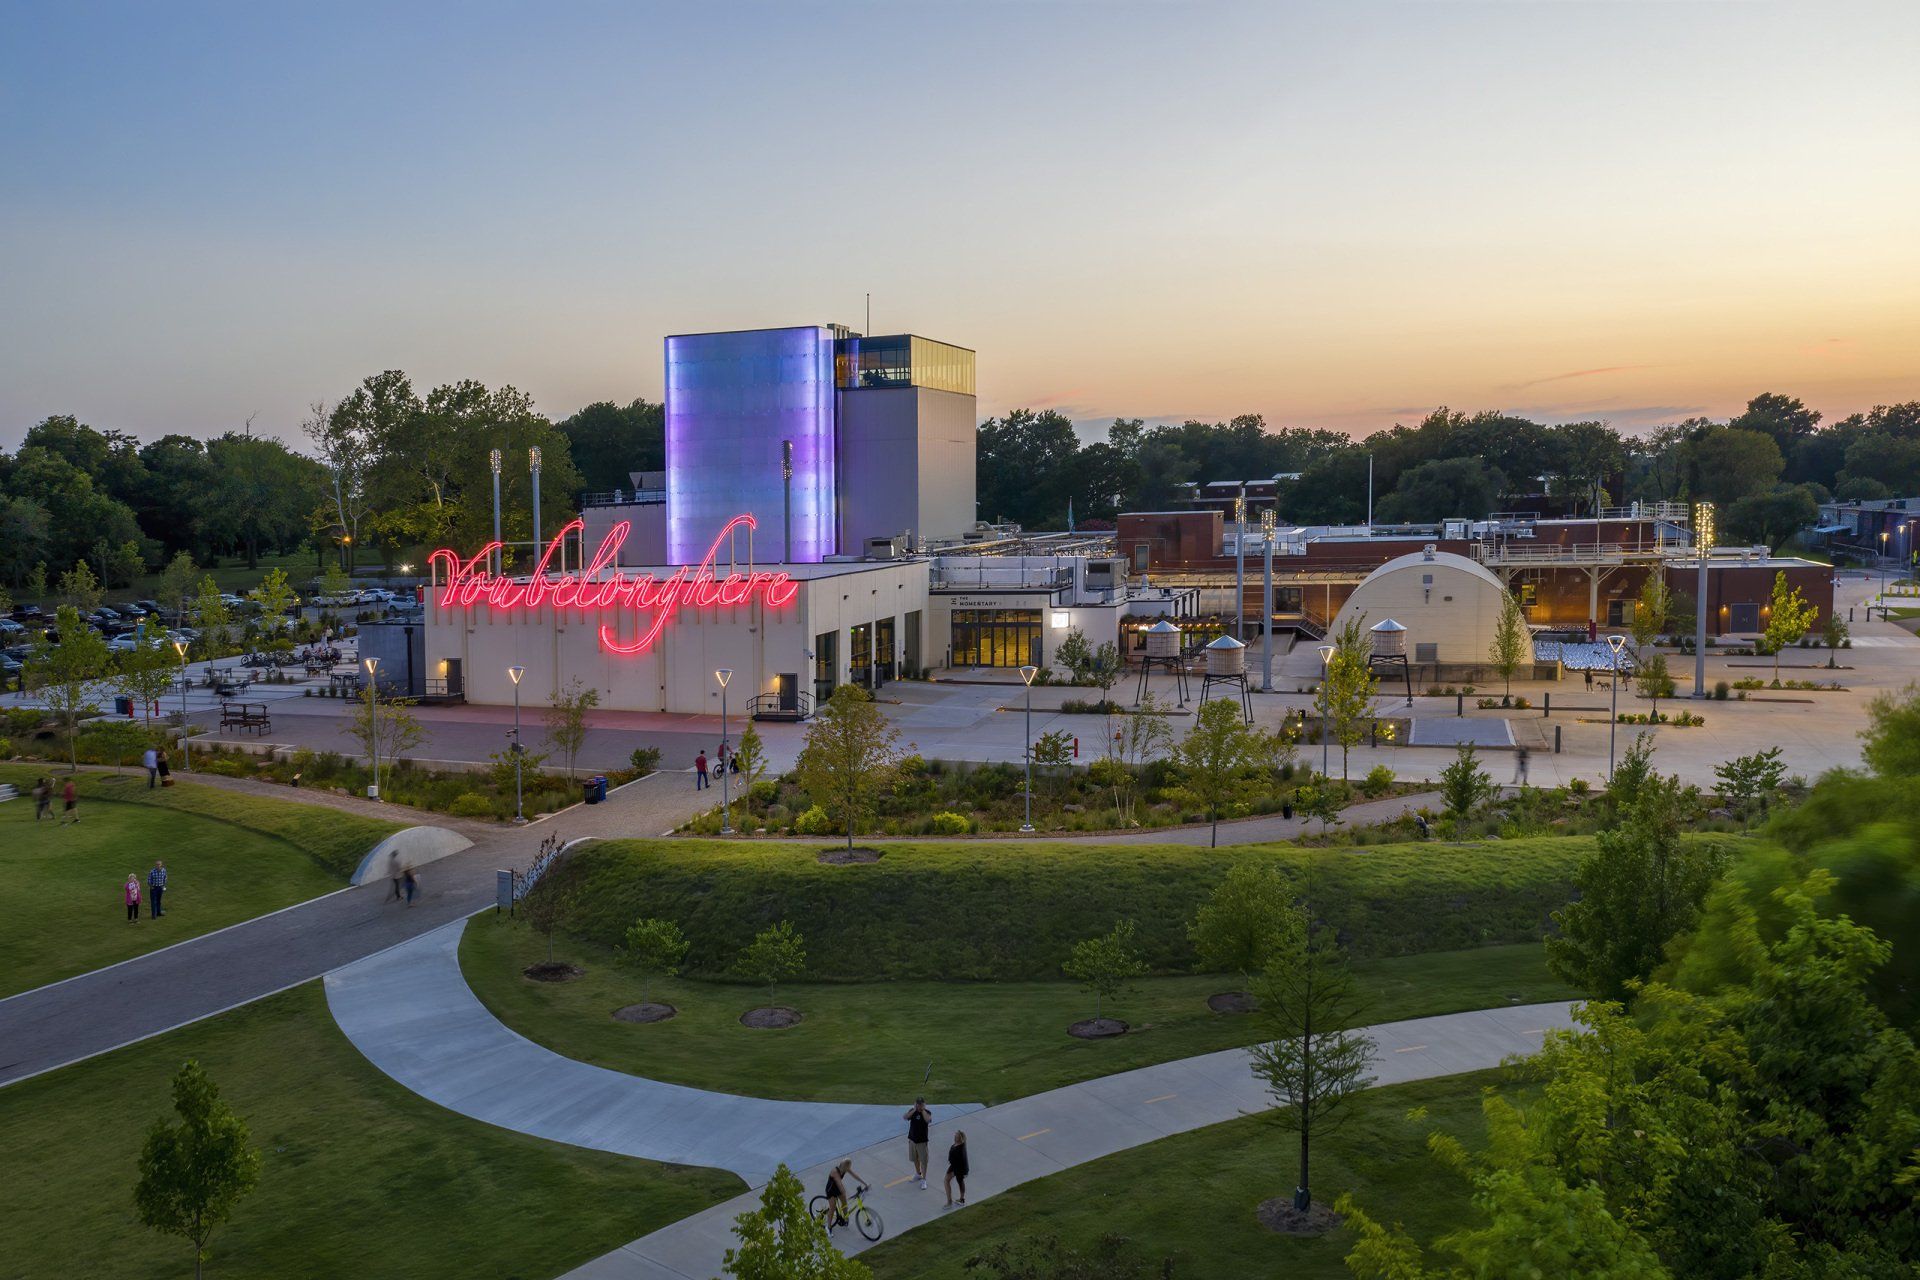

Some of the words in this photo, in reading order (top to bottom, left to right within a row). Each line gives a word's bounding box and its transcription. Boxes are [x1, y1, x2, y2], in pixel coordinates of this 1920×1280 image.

[428, 542, 526, 606] You
[525, 519, 688, 652] belong
[683, 514, 798, 605] here
